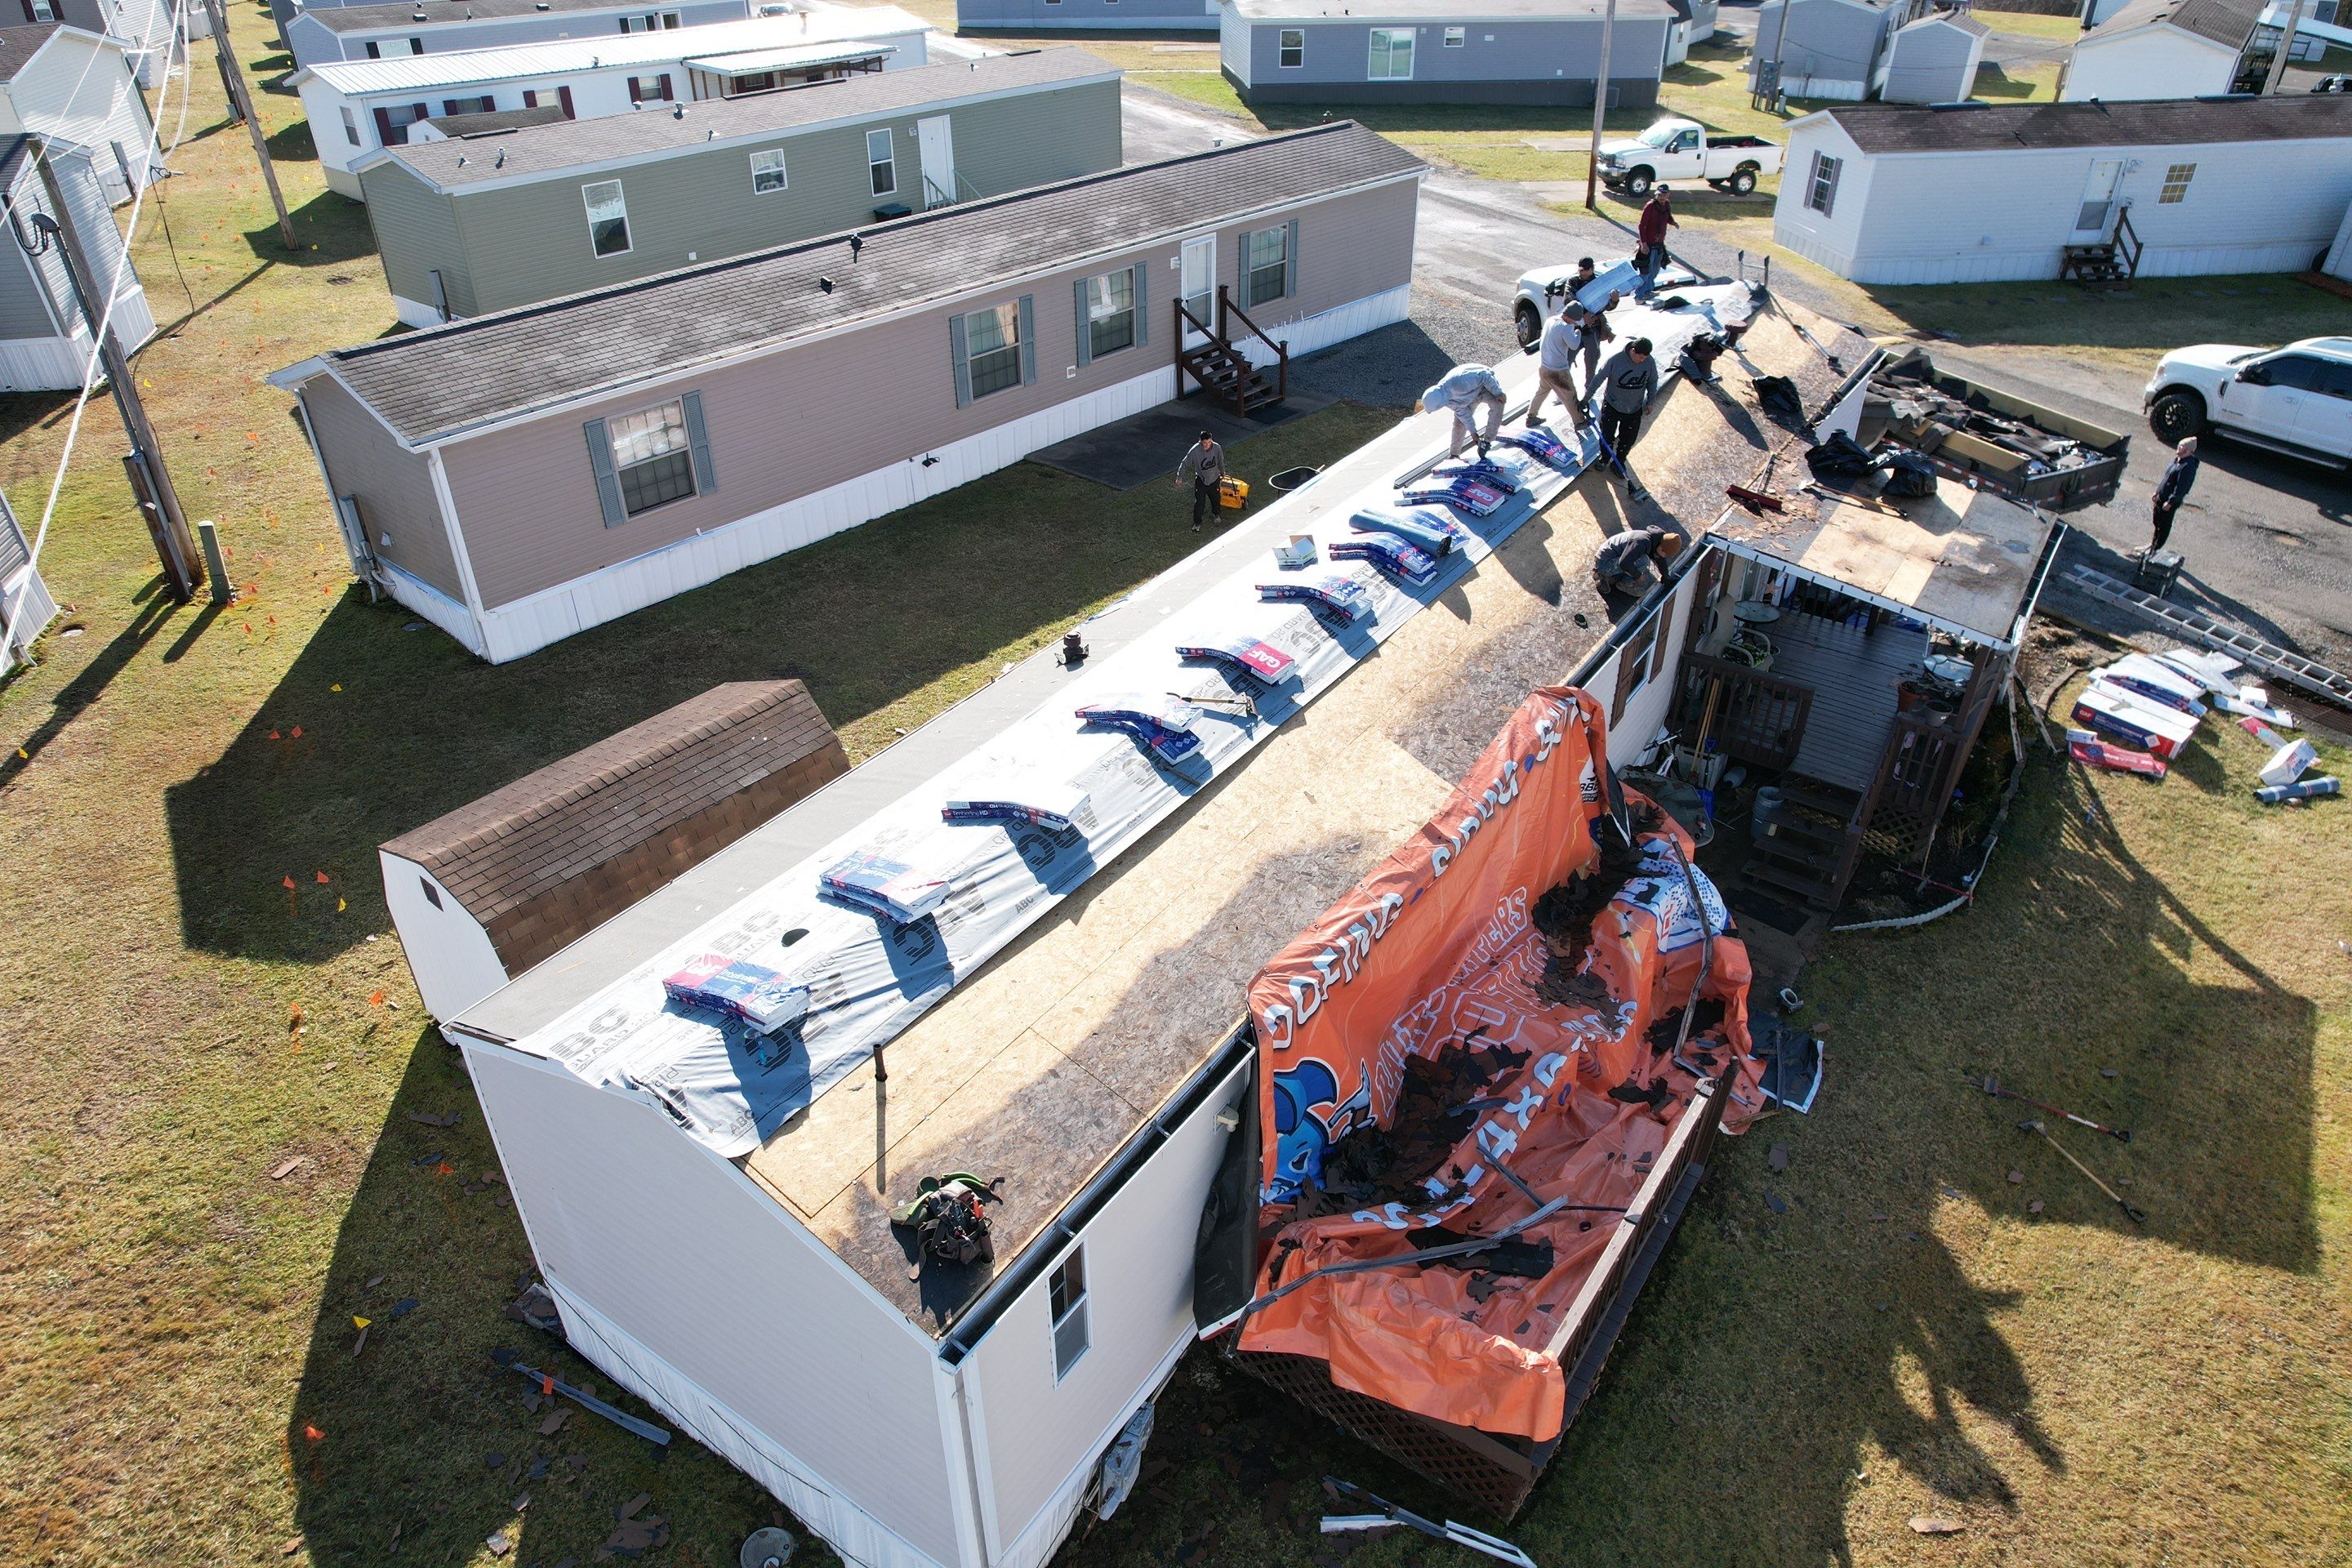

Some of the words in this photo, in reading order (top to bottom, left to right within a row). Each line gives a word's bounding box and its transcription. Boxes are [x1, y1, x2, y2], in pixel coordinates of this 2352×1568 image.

[1200, 457, 1216, 470] Cal
[1470, 488, 1494, 501] GAF
[1247, 650, 1281, 668] GAF
[2078, 709, 2092, 719] GAF
[1015, 895, 1034, 915] ABC
[1263, 893, 1404, 1049] OOFING
[549, 1004, 630, 1061] BC
